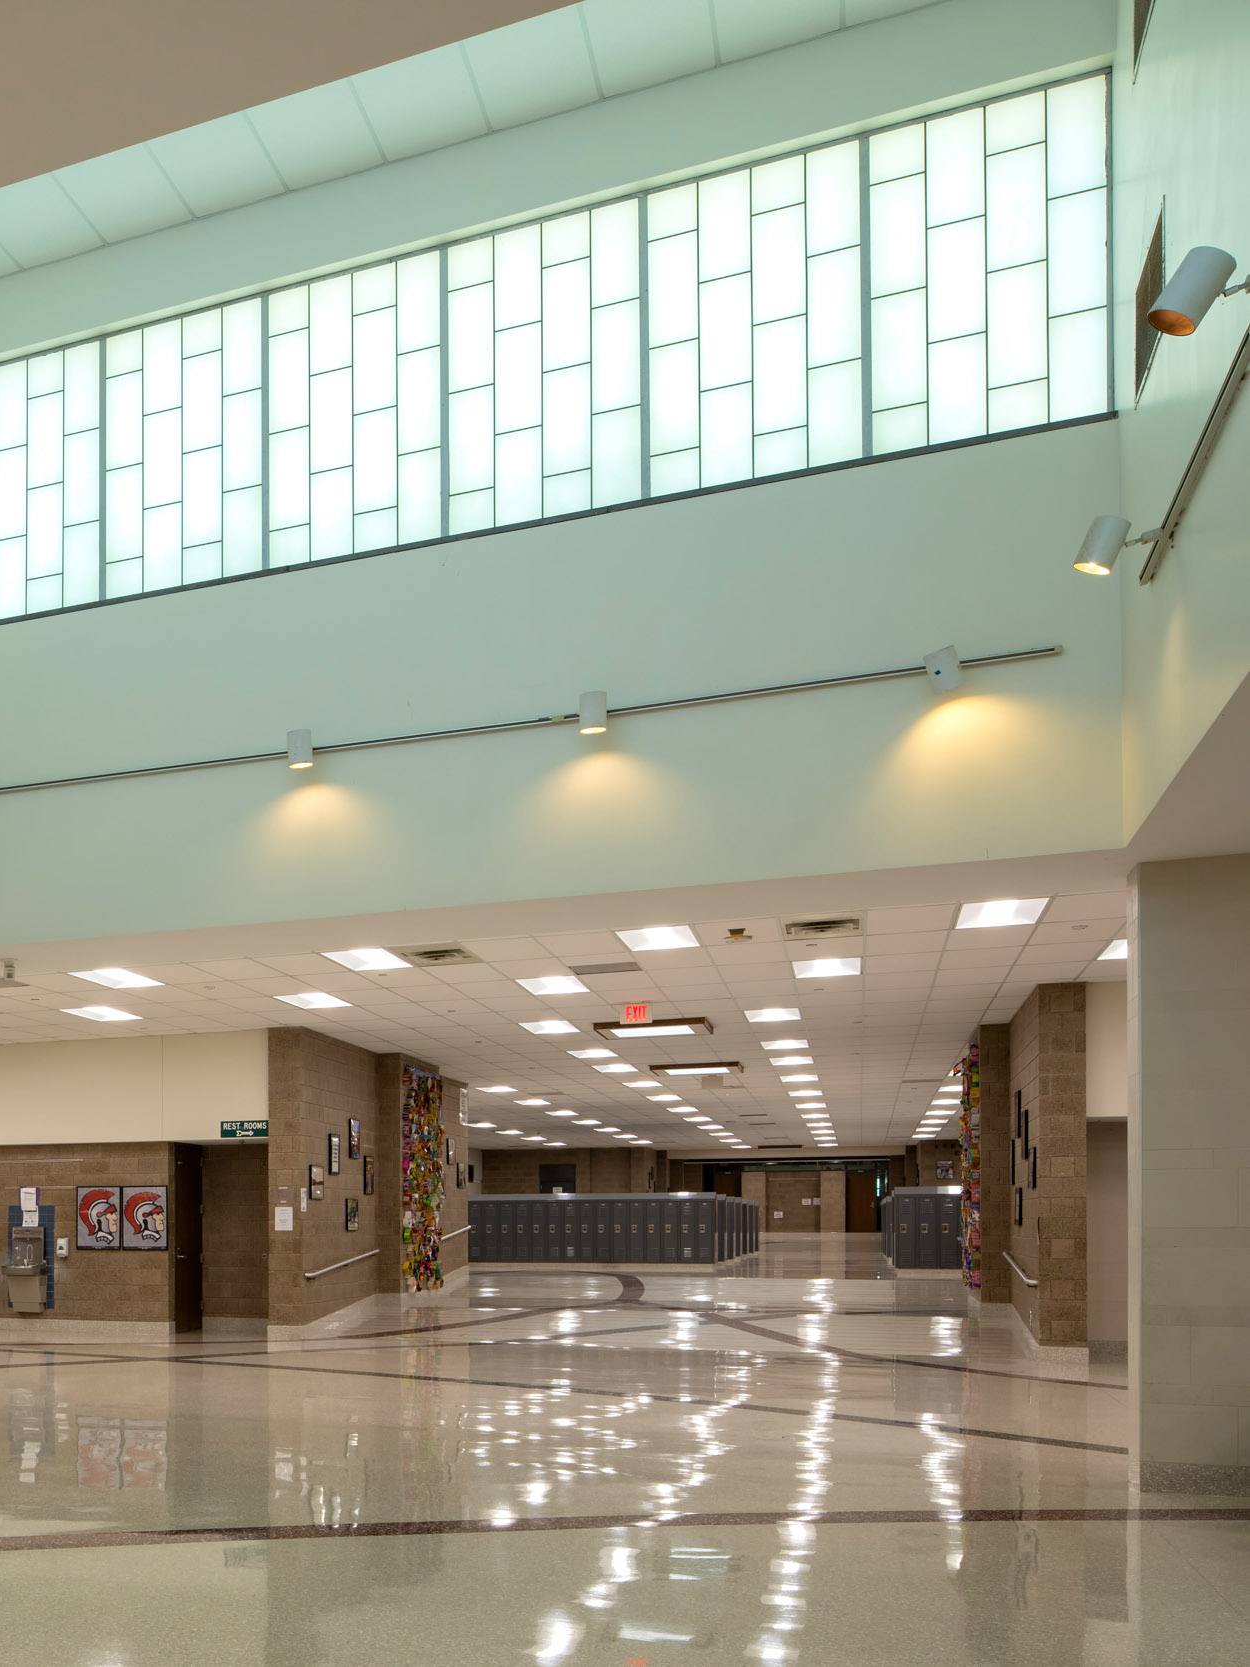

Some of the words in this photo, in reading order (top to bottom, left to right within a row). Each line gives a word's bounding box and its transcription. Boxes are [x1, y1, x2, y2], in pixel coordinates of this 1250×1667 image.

[625, 1005, 648, 1022] EXIT
[223, 1122, 241, 1130] REST
[243, 1121, 267, 1130] ROOMS
